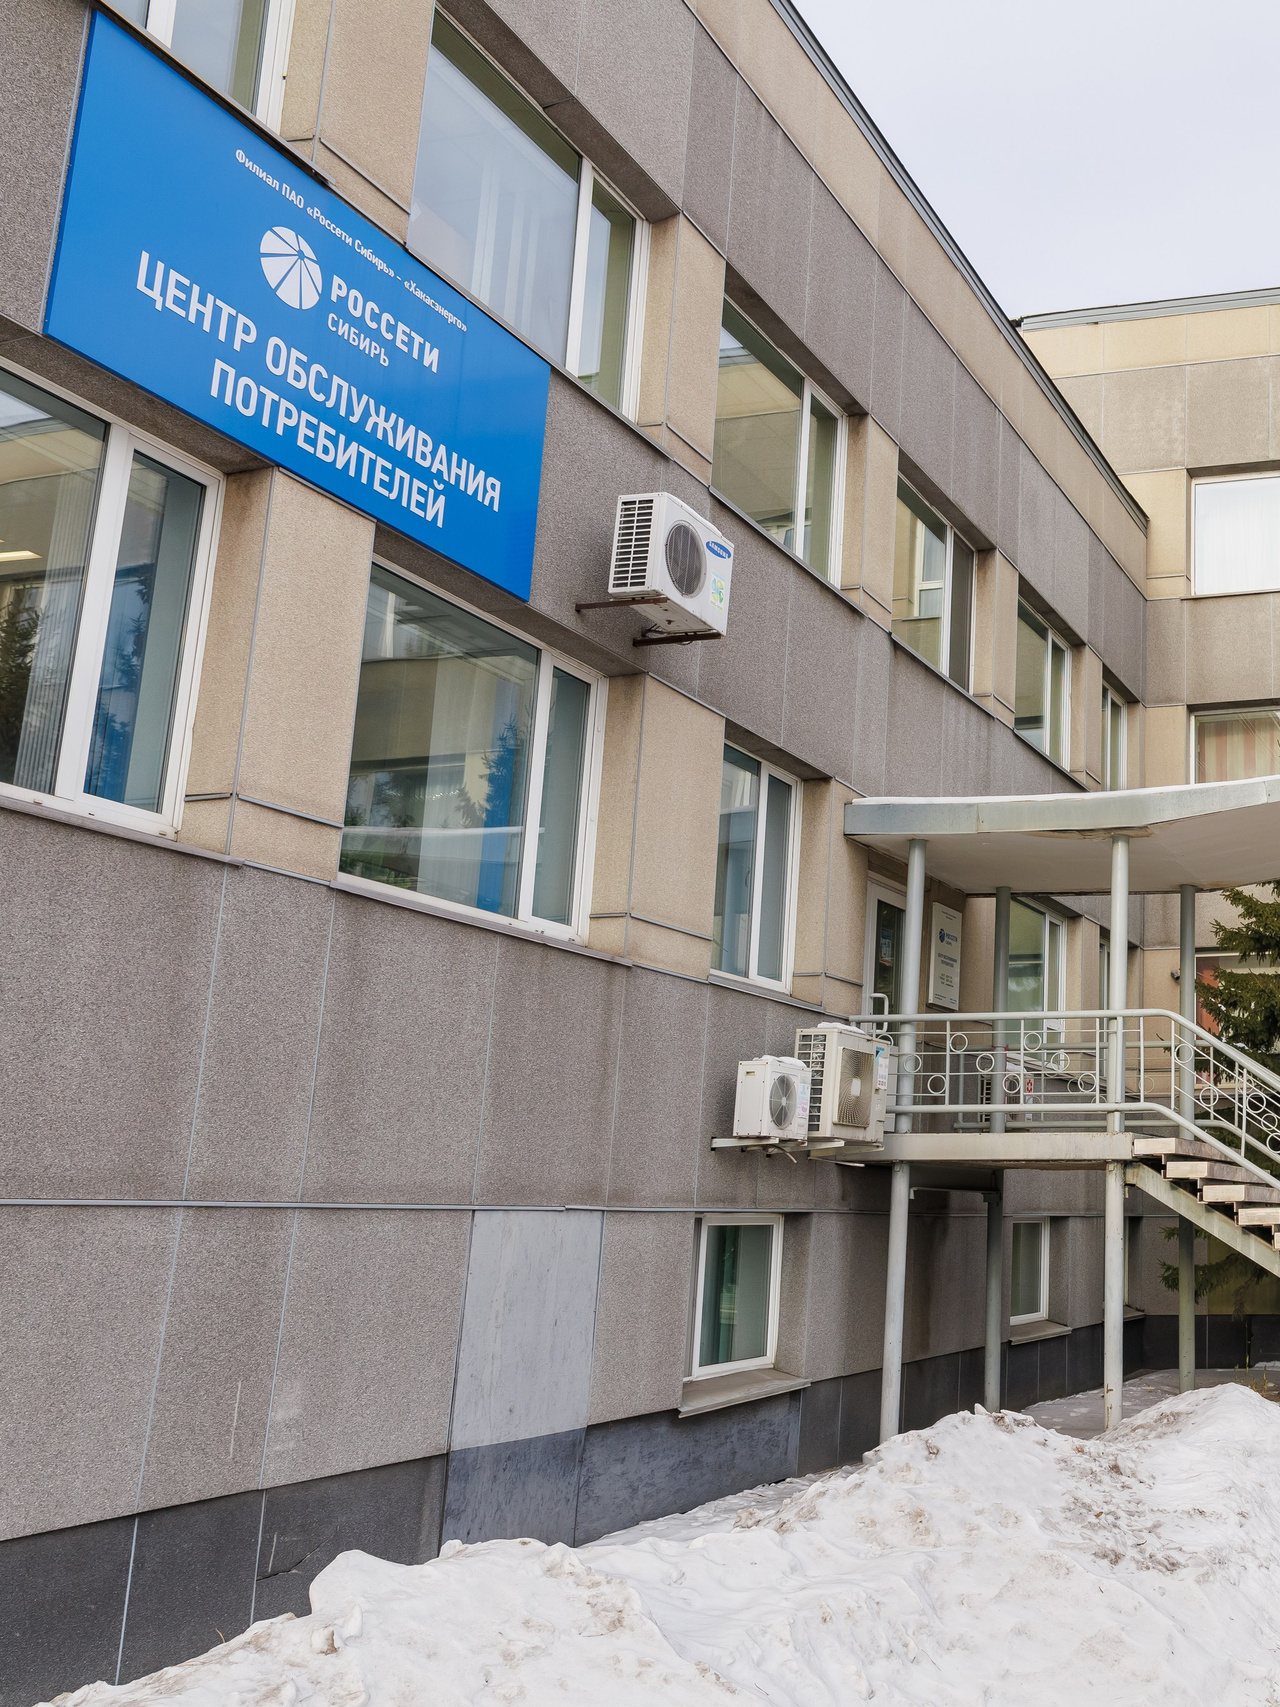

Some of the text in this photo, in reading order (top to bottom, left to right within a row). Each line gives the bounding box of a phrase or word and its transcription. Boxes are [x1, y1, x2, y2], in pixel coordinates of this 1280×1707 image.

[235, 149, 280, 191] Филиал
[281, 183, 305, 209] ПАО
[306, 206, 353, 246] «Россети
[354, 239, 395, 278] Сибирь»
[403, 280, 468, 332] «Хакасэнерго»
[330, 274, 440, 374] РОССЕТИ
[136, 250, 501, 512] ЦЕНТР ОБСЛУЖИВАНИЯ
[327, 312, 389, 367] СИБИРЬ
[210, 358, 446, 528] ПОТРЕБИТЕЛЕЙ
